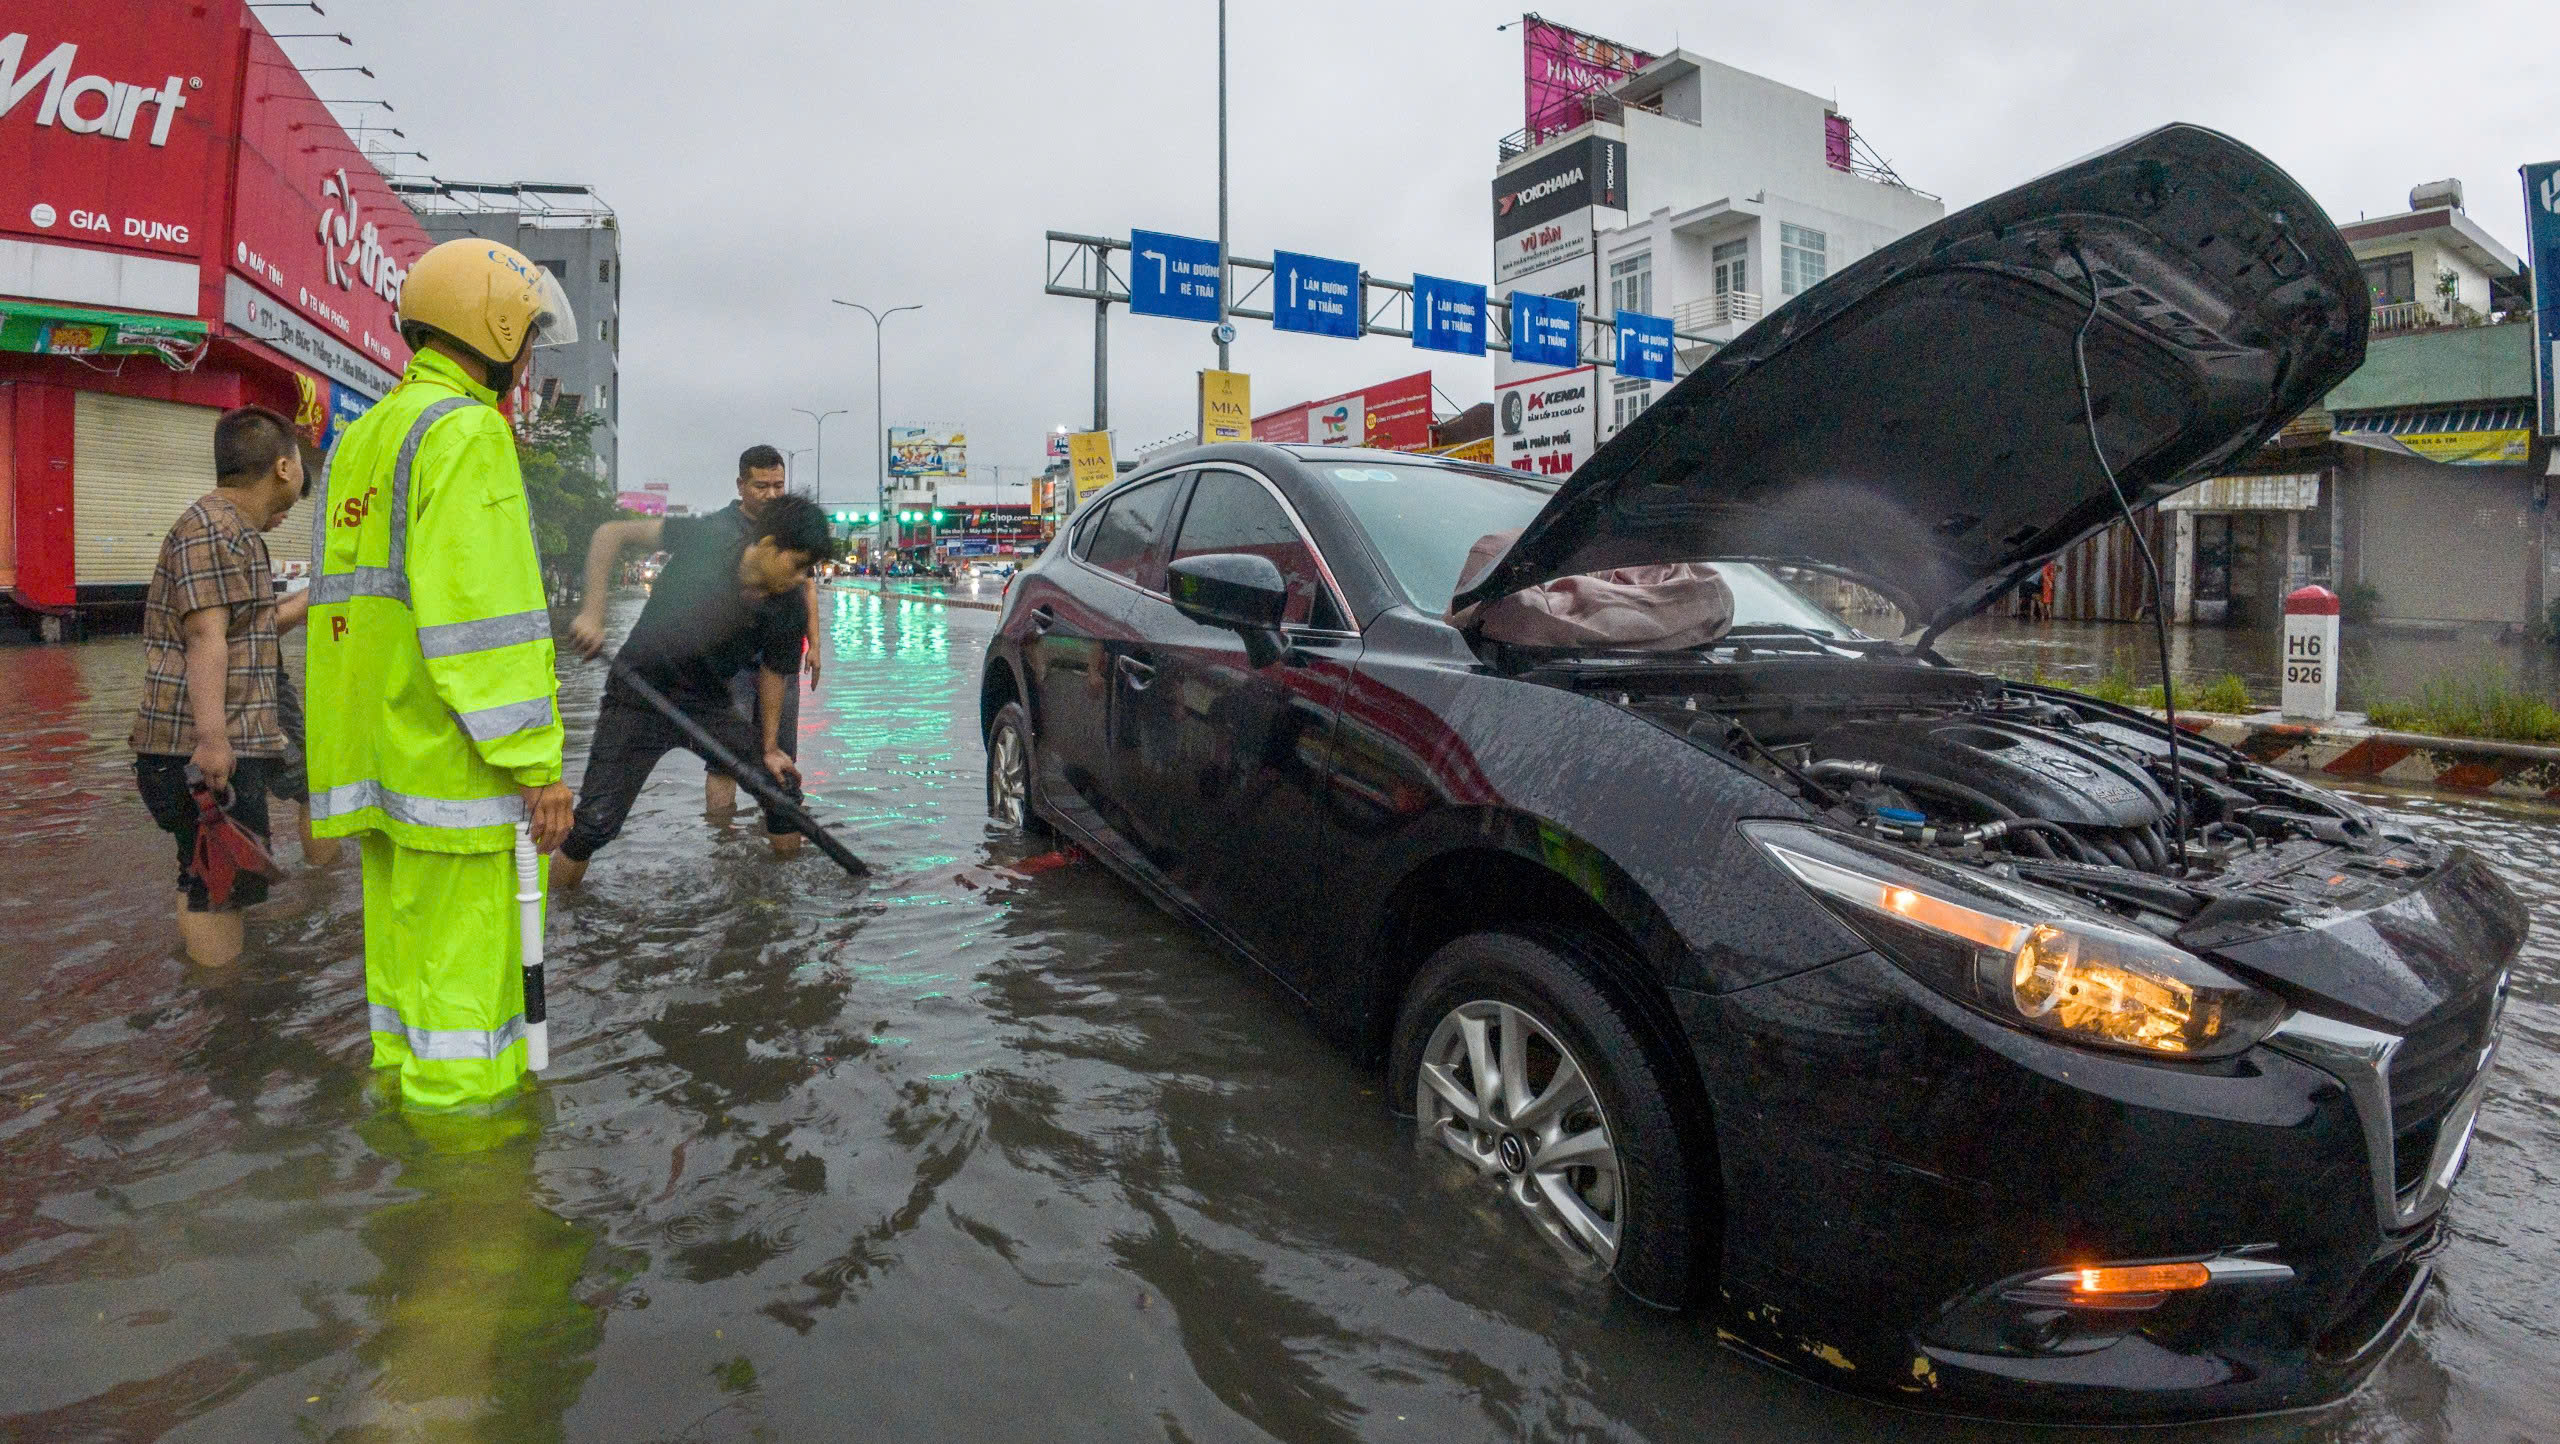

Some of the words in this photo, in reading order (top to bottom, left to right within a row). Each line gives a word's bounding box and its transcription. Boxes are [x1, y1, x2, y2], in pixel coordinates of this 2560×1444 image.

[1547, 58, 1615, 91] HAWO
[1606, 144, 1614, 189] YOKOHAMA
[1518, 167, 1584, 206] YOKOHAMA
[69, 209, 111, 233] GIA
[124, 217, 189, 243] DỤNG
[1520, 232, 1537, 253] VŨ
[1538, 226, 1562, 247] TÂN
[249, 251, 266, 275] MÁY
[268, 263, 284, 288] TÍNH
[1172, 260, 1190, 275] LÀN
[1180, 281, 1192, 295] RẼ
[1195, 284, 1214, 298] TRÁI
[1303, 276, 1319, 291] LÀN
[1322, 280, 1349, 297] ĐƯỜNG
[308, 294, 318, 312] TB
[318, 301, 331, 321] VĂN
[330, 310, 350, 334] PHÒNG
[1307, 300, 1316, 311] ĐI
[1438, 300, 1451, 312] LÀN
[1453, 302, 1476, 317] ĐƯỜNG
[1441, 319, 1449, 331] ĐI
[1535, 316, 1549, 328] LÀN
[1550, 317, 1570, 331] ĐƯỜNG
[1538, 334, 1547, 346] ĐI
[1638, 332, 1650, 345] LÀN
[1650, 334, 1669, 348] ĐƯỜNG
[1545, 386, 1586, 405] KENDA
[1211, 401, 1243, 415] MIA
[1560, 408, 1573, 416] CAO
[1573, 403, 1585, 413] CẤP
[1513, 438, 1528, 451] NHÀ
[1530, 435, 1550, 448] PHÂN
[1552, 430, 1571, 446] PHỐI
[1079, 457, 1106, 467] MIA
[1539, 450, 1573, 474] TÂN
[2289, 635, 2321, 656] H6
[2288, 666, 2322, 684] 926
